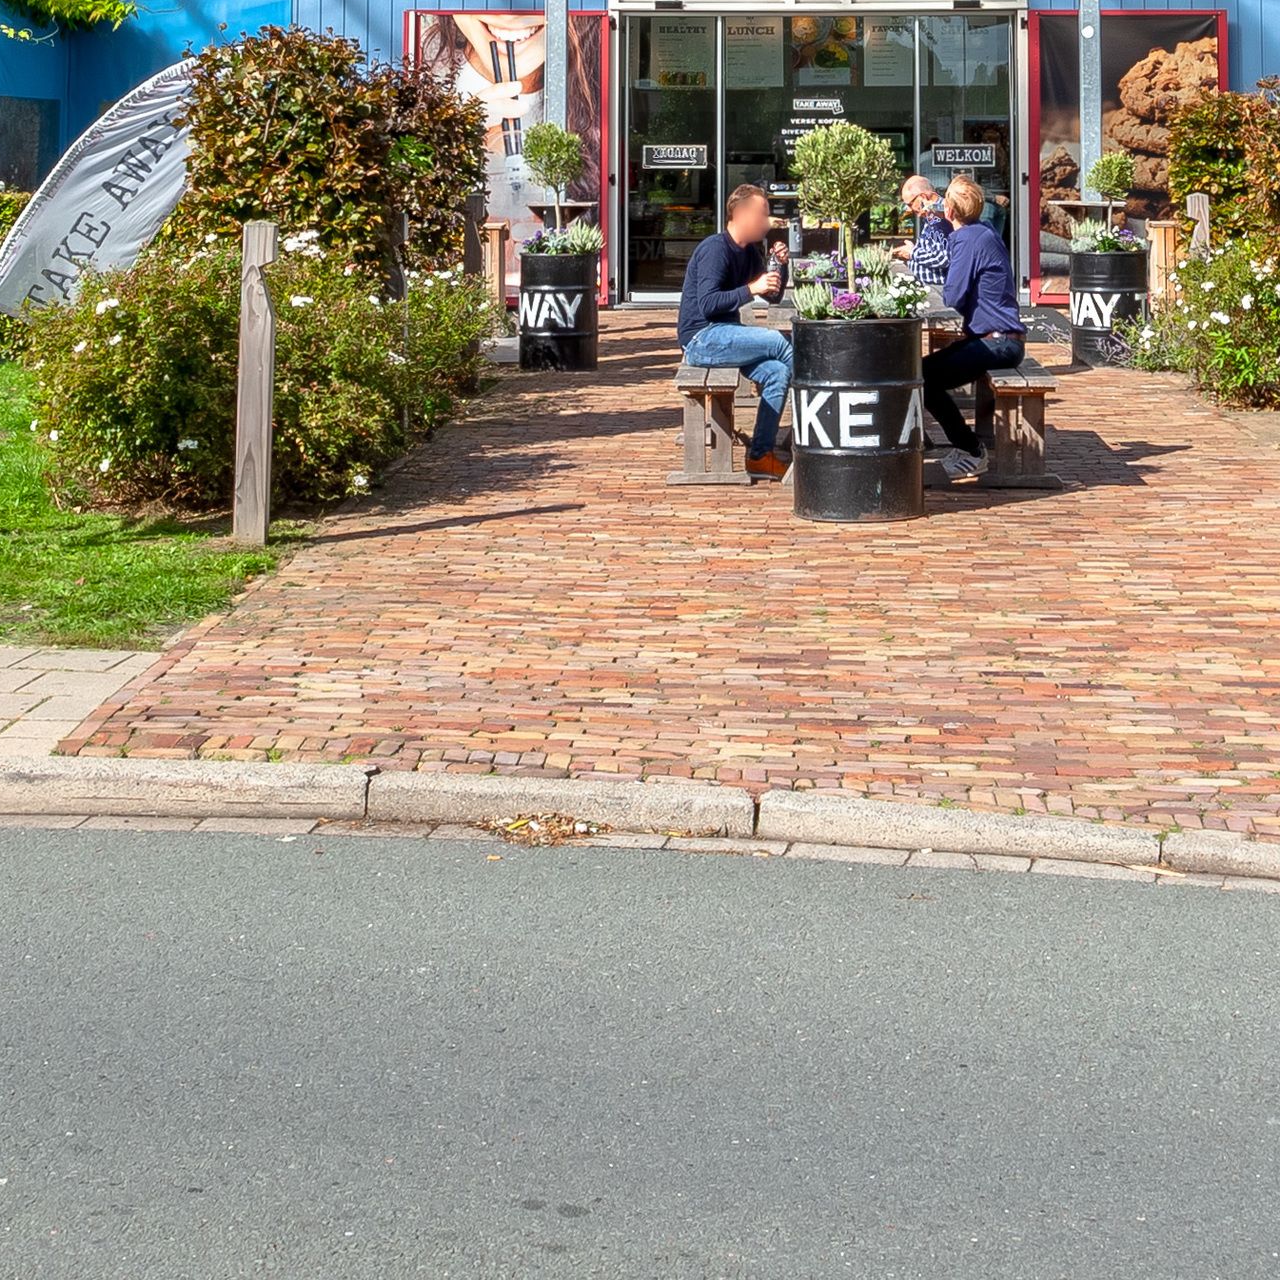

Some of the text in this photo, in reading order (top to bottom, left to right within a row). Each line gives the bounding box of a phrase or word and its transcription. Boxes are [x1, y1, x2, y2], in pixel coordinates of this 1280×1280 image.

[658, 25, 708, 34] HEALTHY
[726, 26, 776, 36] LUNCH
[936, 148, 992, 162] WELKOM
